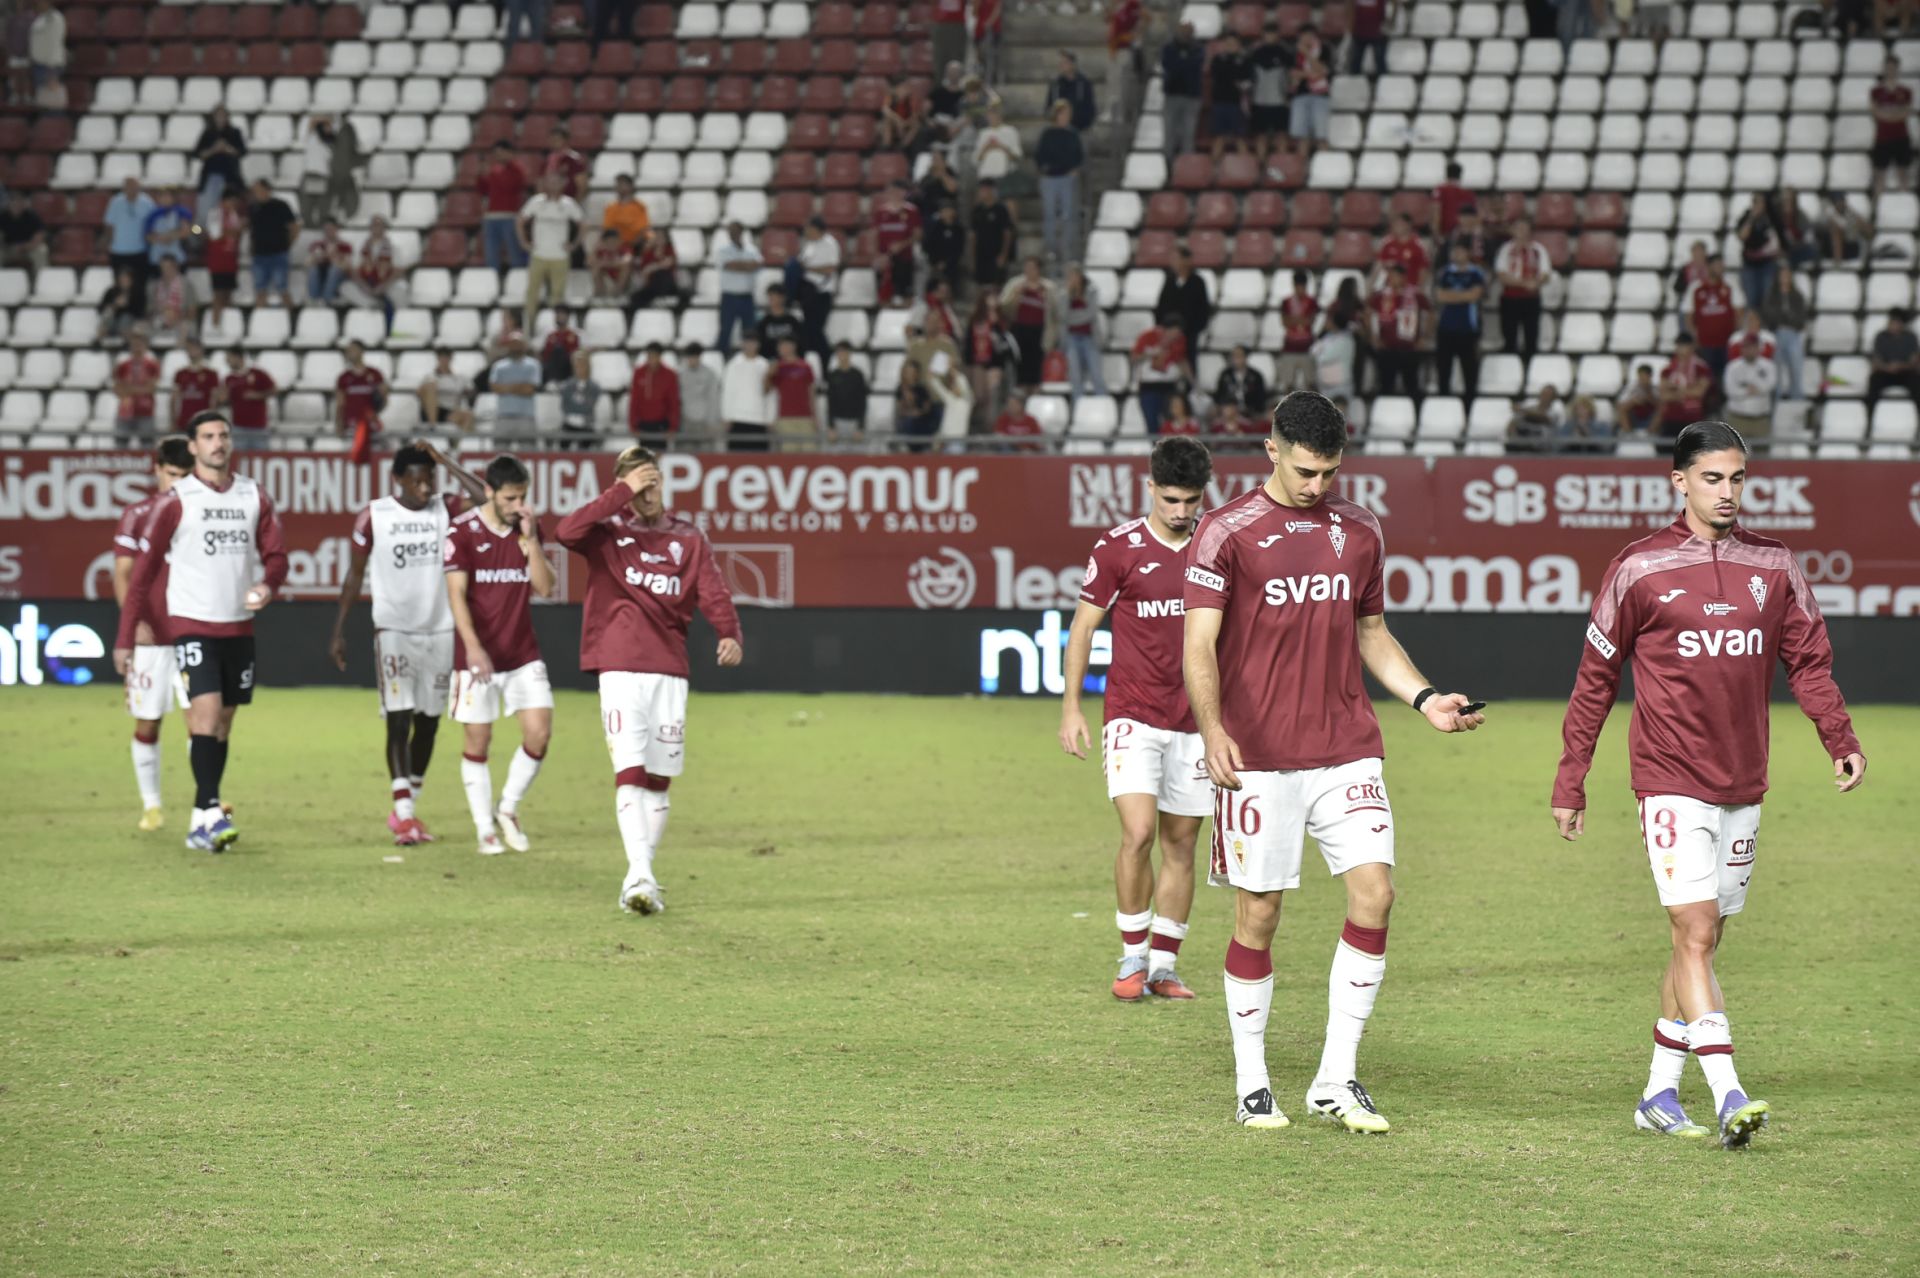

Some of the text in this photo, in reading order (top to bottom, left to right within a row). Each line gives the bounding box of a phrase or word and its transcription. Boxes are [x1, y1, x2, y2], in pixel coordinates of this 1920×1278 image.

[0, 456, 153, 521] idas
[660, 454, 979, 512] Prevemur
[1554, 473, 1814, 513] SEIBCK
[854, 512, 871, 532] Y
[884, 511, 977, 533] SALUD
[1329, 512, 1342, 523] 16
[204, 530, 249, 555] gesa
[1192, 570, 1222, 588] TECH
[1264, 573, 1350, 606] svan
[1384, 555, 1593, 612] oma
[1589, 627, 1613, 655] TECH
[1677, 628, 1763, 658] svan
[1113, 722, 1133, 751] 2
[1346, 783, 1386, 802] CRC
[1226, 791, 1262, 836] 16
[1654, 808, 1678, 849] 3
[1731, 838, 1756, 855] CR
